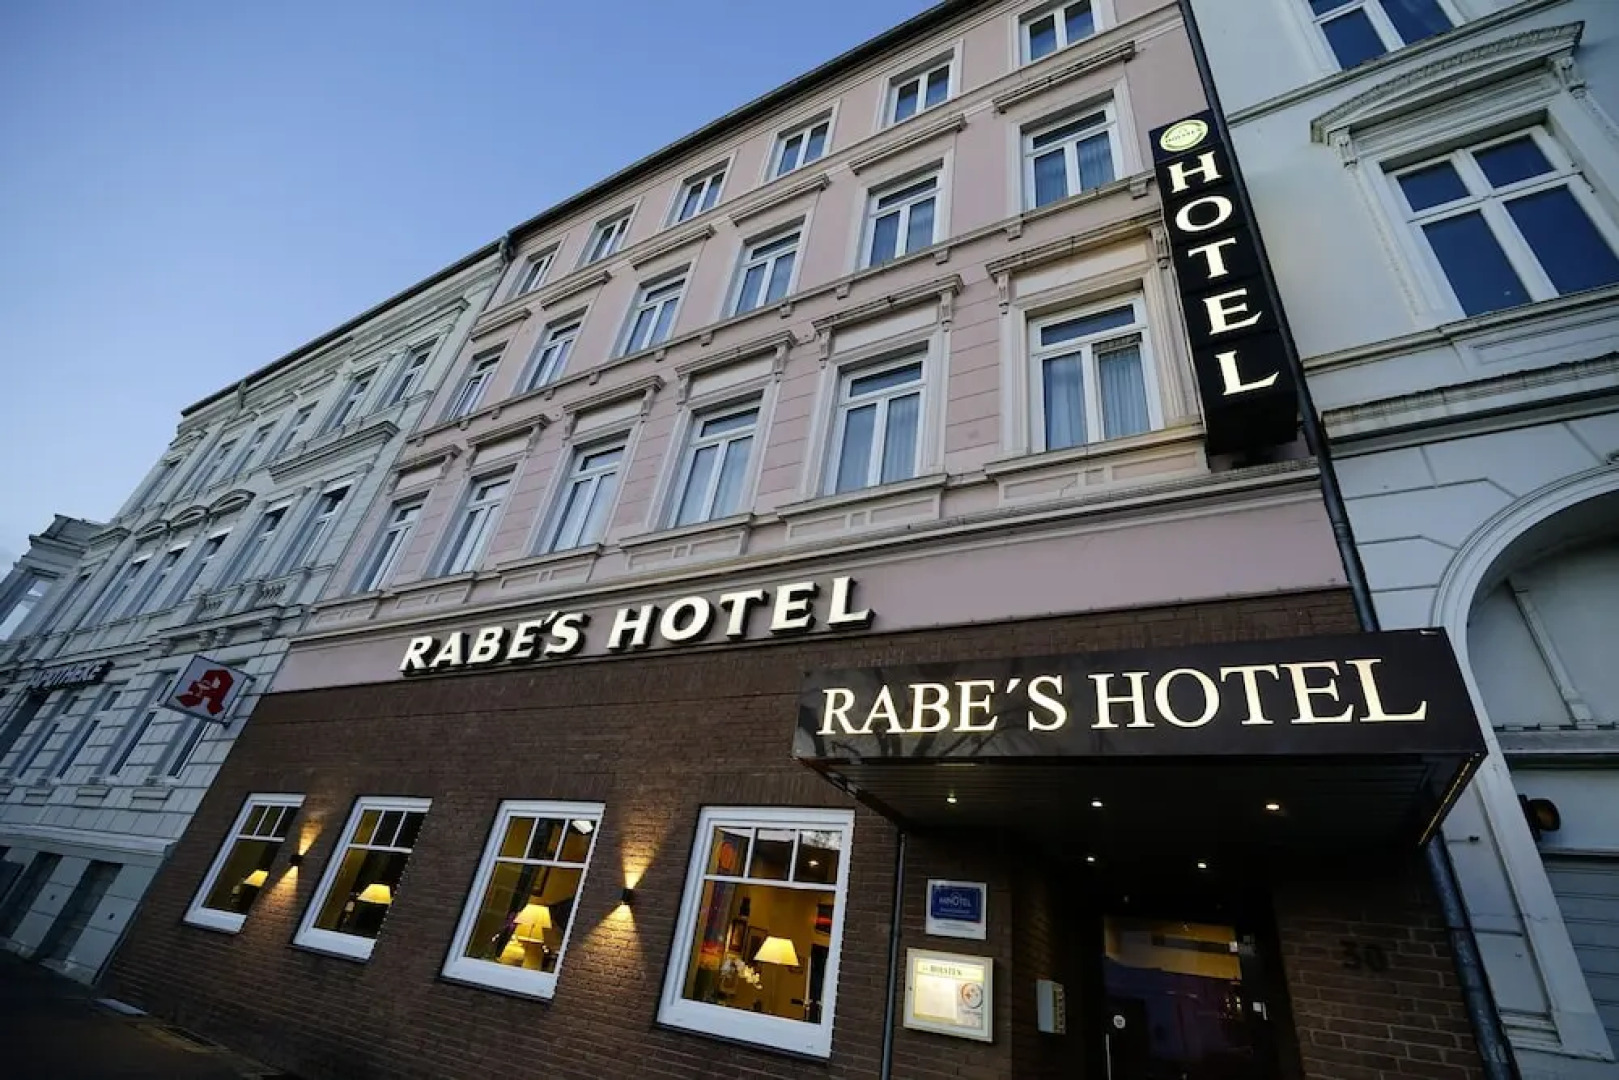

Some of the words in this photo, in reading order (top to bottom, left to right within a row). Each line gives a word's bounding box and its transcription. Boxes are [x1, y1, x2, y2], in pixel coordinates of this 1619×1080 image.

[1168, 150, 1280, 397] HOTEL
[606, 576, 873, 651] HOTEL
[1087, 658, 1429, 730] HOTEL
